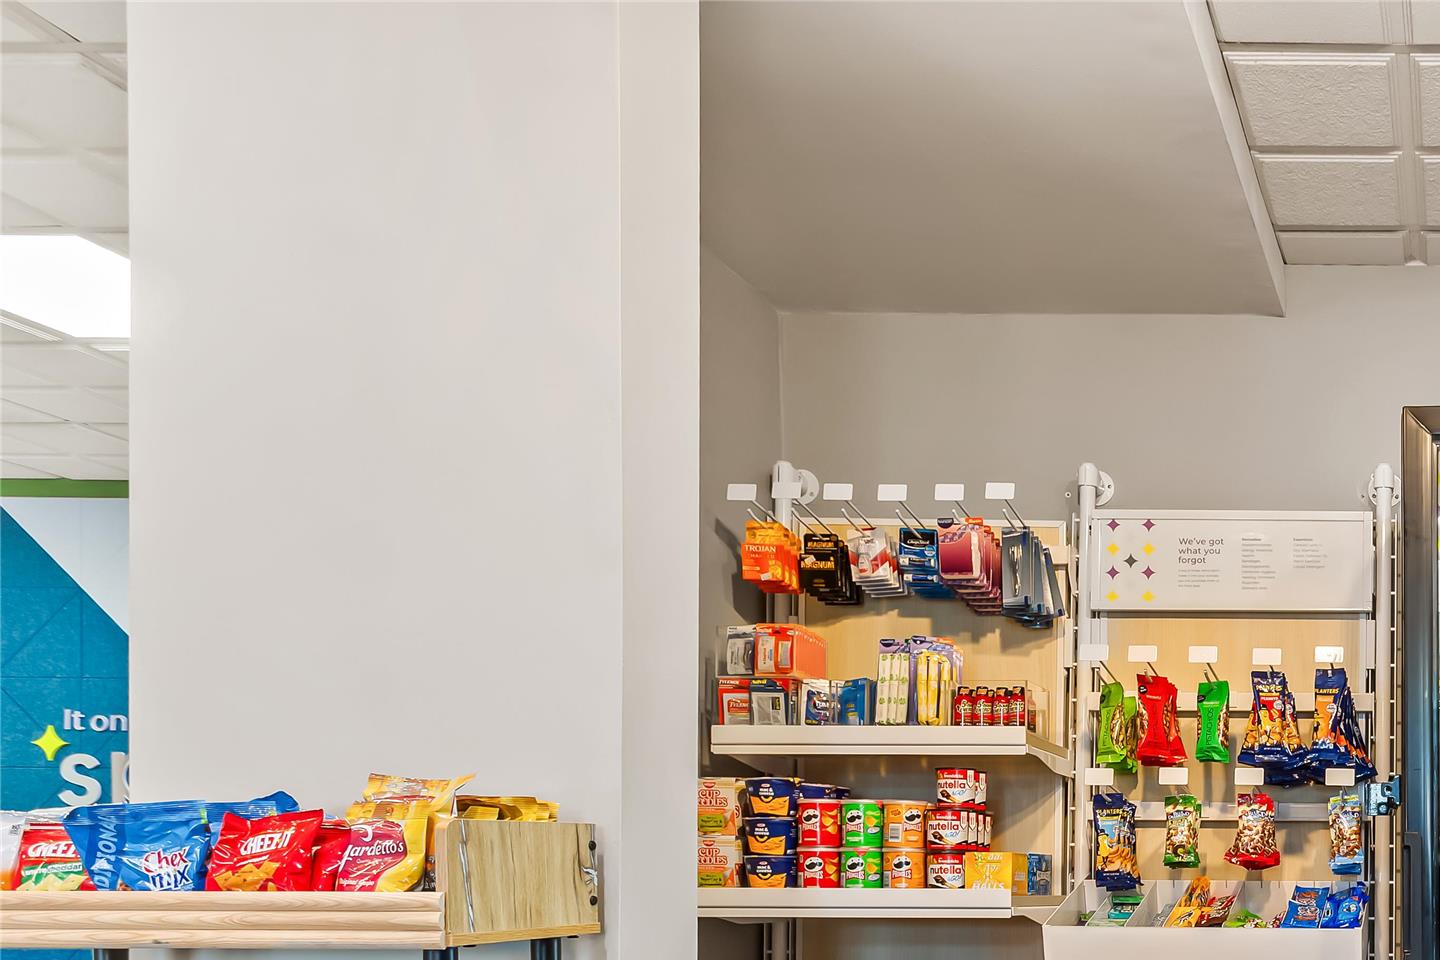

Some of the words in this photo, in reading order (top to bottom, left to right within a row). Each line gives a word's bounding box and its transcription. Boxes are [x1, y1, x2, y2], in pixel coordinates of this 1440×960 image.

[1178, 537, 1206, 546] We've
[1208, 538, 1225, 547] got
[745, 544, 777, 552] TROJAN
[1178, 547, 1201, 555] what
[1203, 549, 1221, 557] you
[1178, 556, 1206, 566] forgot
[699, 789, 721, 798] CUP
[929, 822, 960, 831] nutella
[699, 848, 720, 856] CUP
[930, 866, 961, 875] nutella
